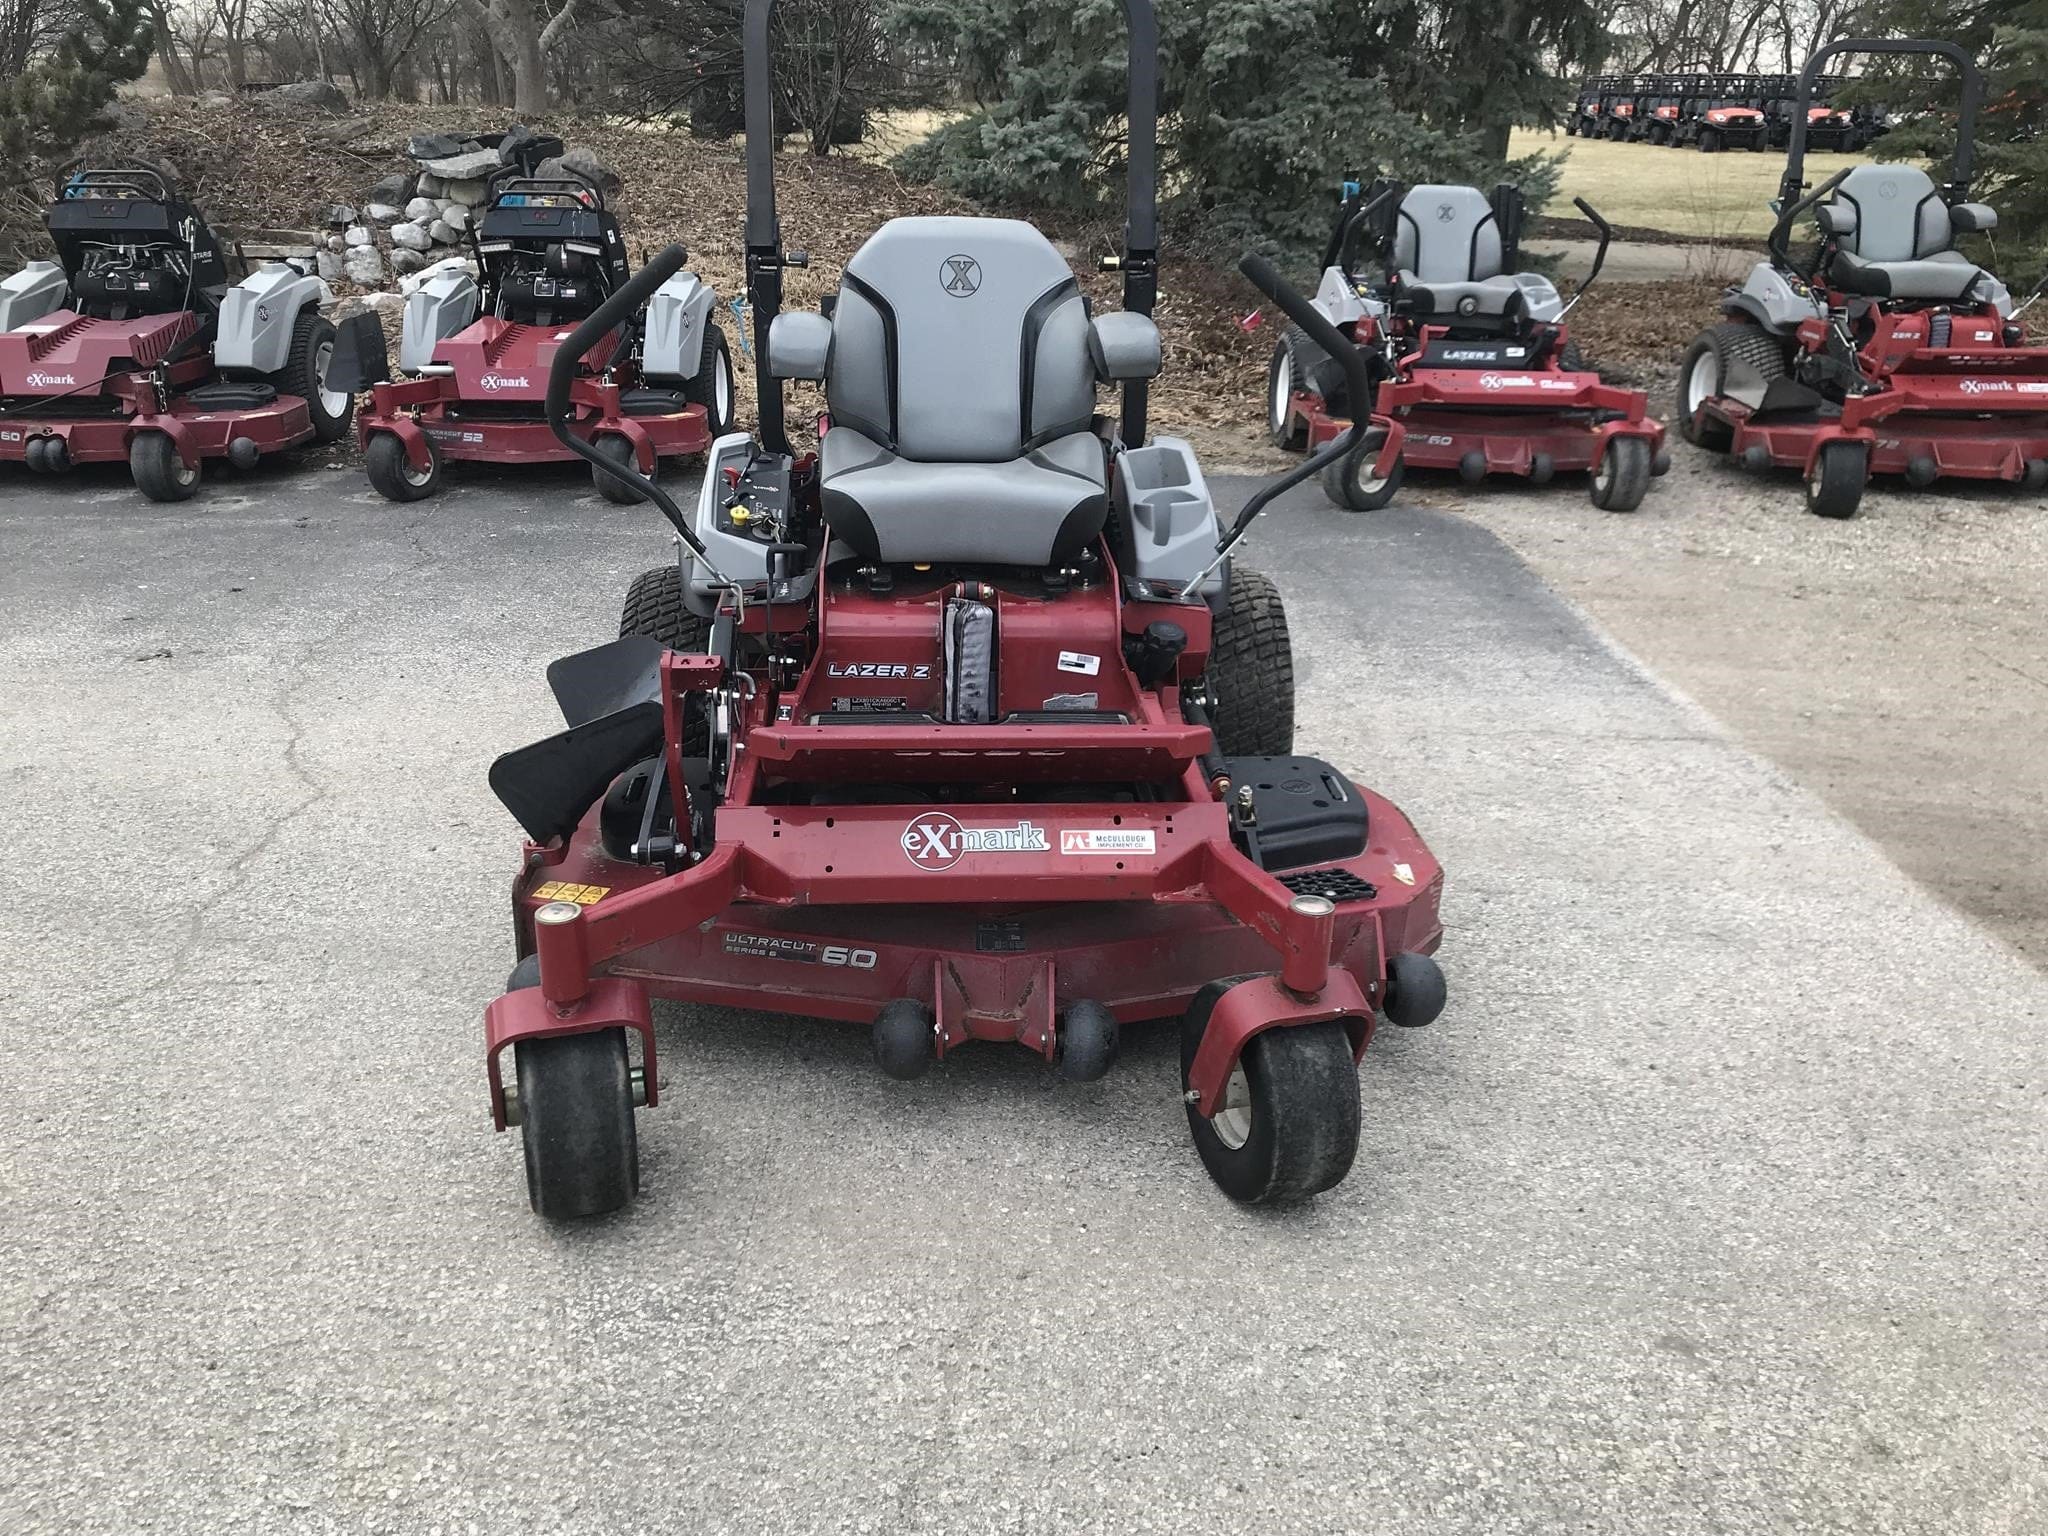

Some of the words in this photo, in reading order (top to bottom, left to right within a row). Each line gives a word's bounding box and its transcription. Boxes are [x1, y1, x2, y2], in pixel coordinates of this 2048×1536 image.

[26, 371, 76, 387] eXmark
[480, 375, 530, 389] eXmark
[1959, 380, 2013, 393] eXmark
[1, 432, 20, 442] 60
[463, 432, 484, 443] 52
[1428, 435, 1453, 446] 60
[827, 663, 909, 678] LAZER
[911, 664, 931, 679] Z
[902, 820, 1048, 860] eXmark
[726, 945, 766, 956] SERIES
[726, 933, 817, 952] ULTRACUT
[821, 945, 878, 969] 60
